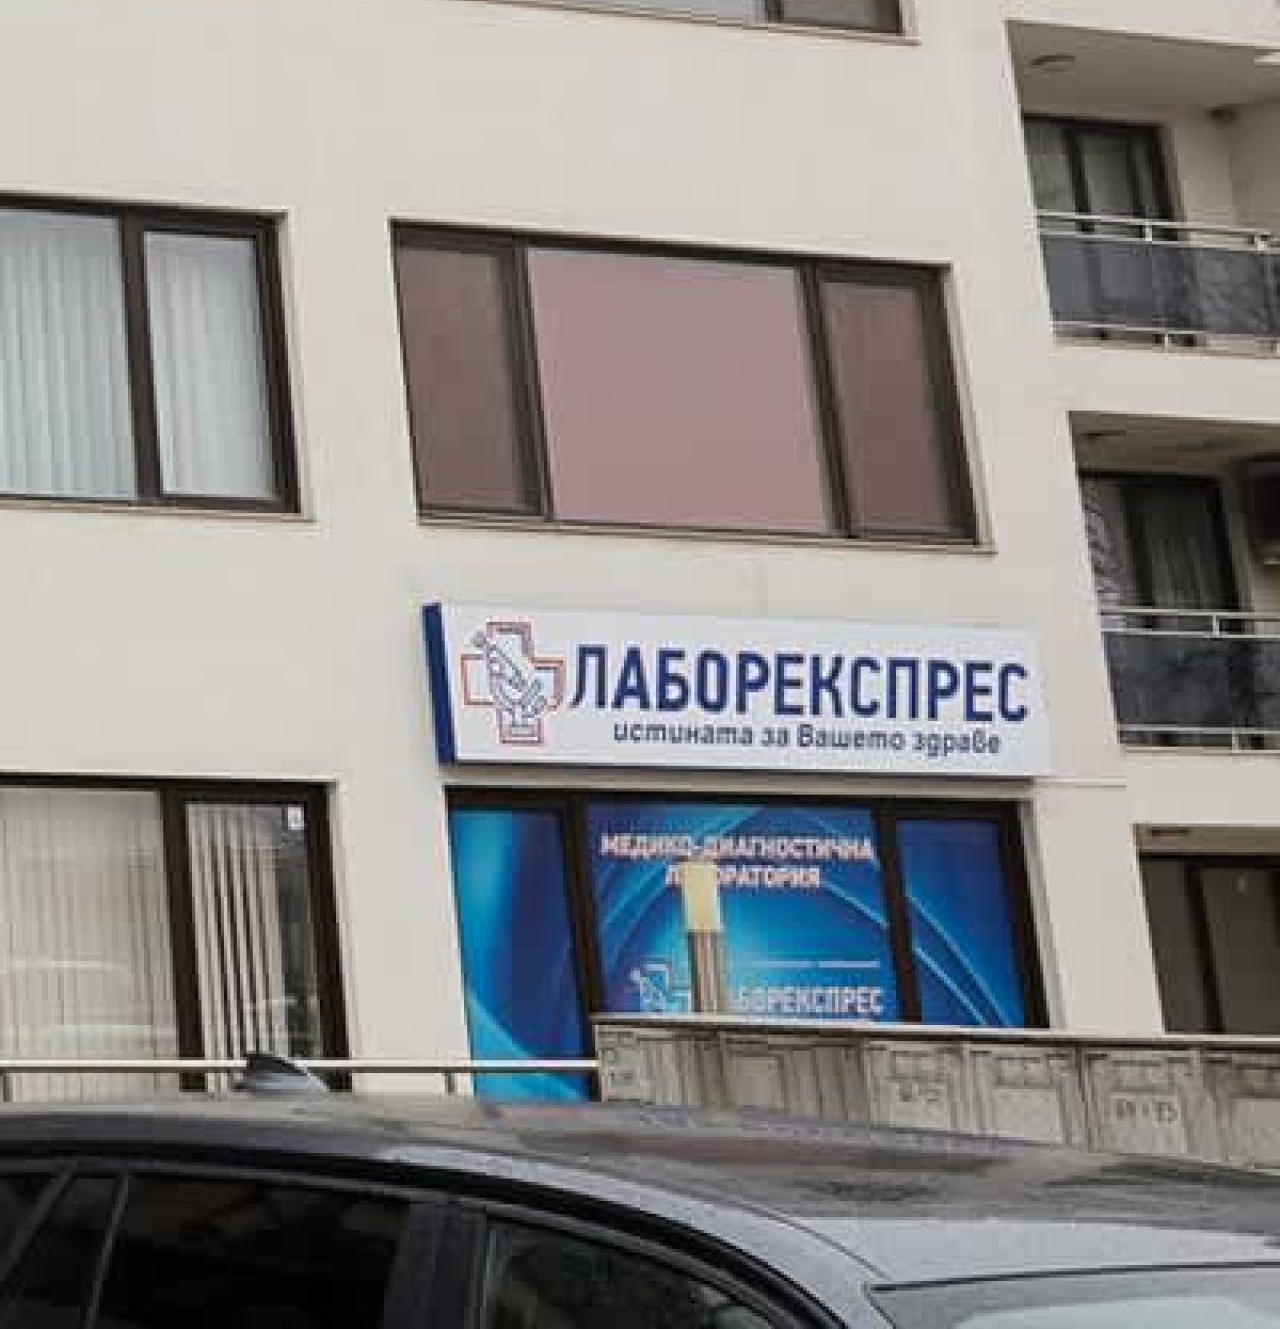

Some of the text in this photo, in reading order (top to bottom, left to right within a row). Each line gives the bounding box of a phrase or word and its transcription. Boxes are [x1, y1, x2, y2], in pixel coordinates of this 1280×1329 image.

[569, 643, 1029, 723] ЛАБОРЕКСПРЕС
[612, 720, 1002, 757] истината за Вашето здраве
